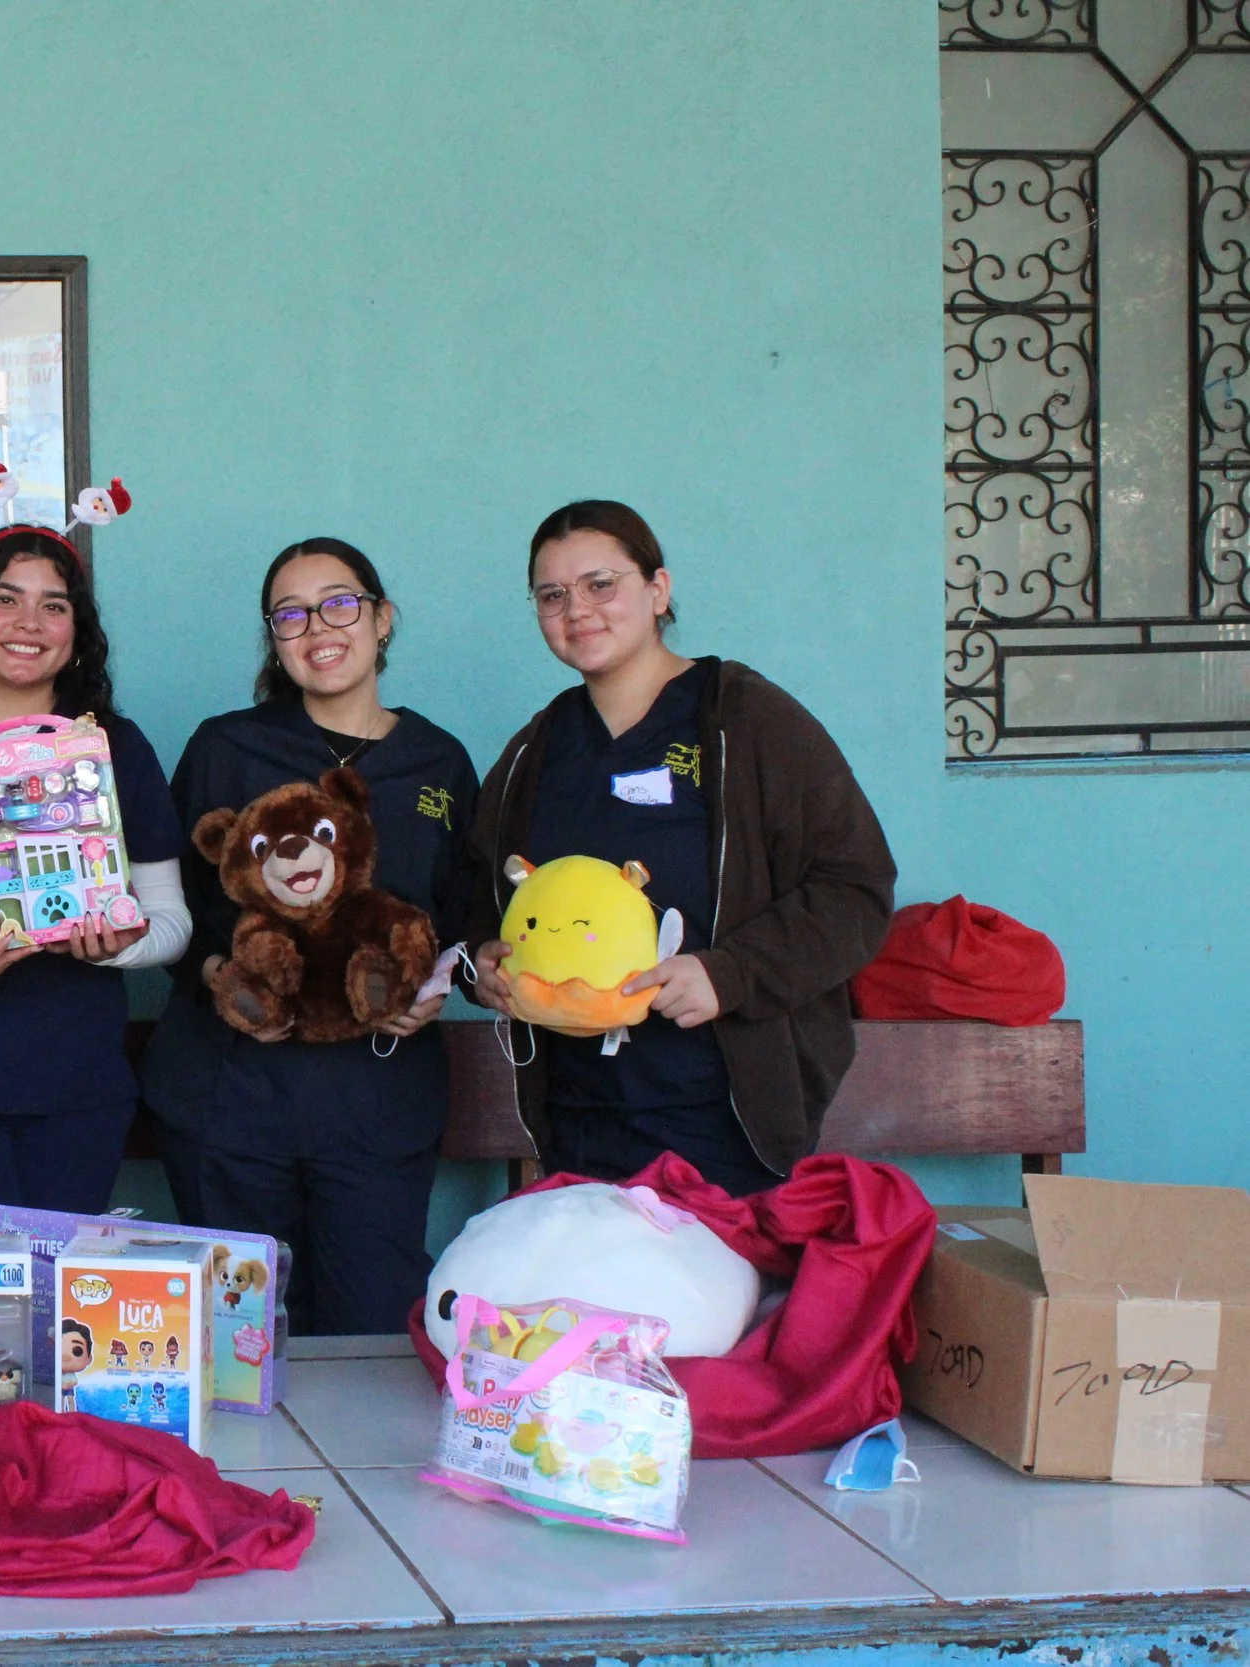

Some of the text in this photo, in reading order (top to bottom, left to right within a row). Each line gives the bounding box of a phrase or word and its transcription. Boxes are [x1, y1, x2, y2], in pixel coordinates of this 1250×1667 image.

[30, 1239, 65, 1257] ITTIES
[2, 1268, 23, 1282] 1100
[70, 1278, 111, 1299] POP!
[119, 1300, 164, 1332] LUCA
